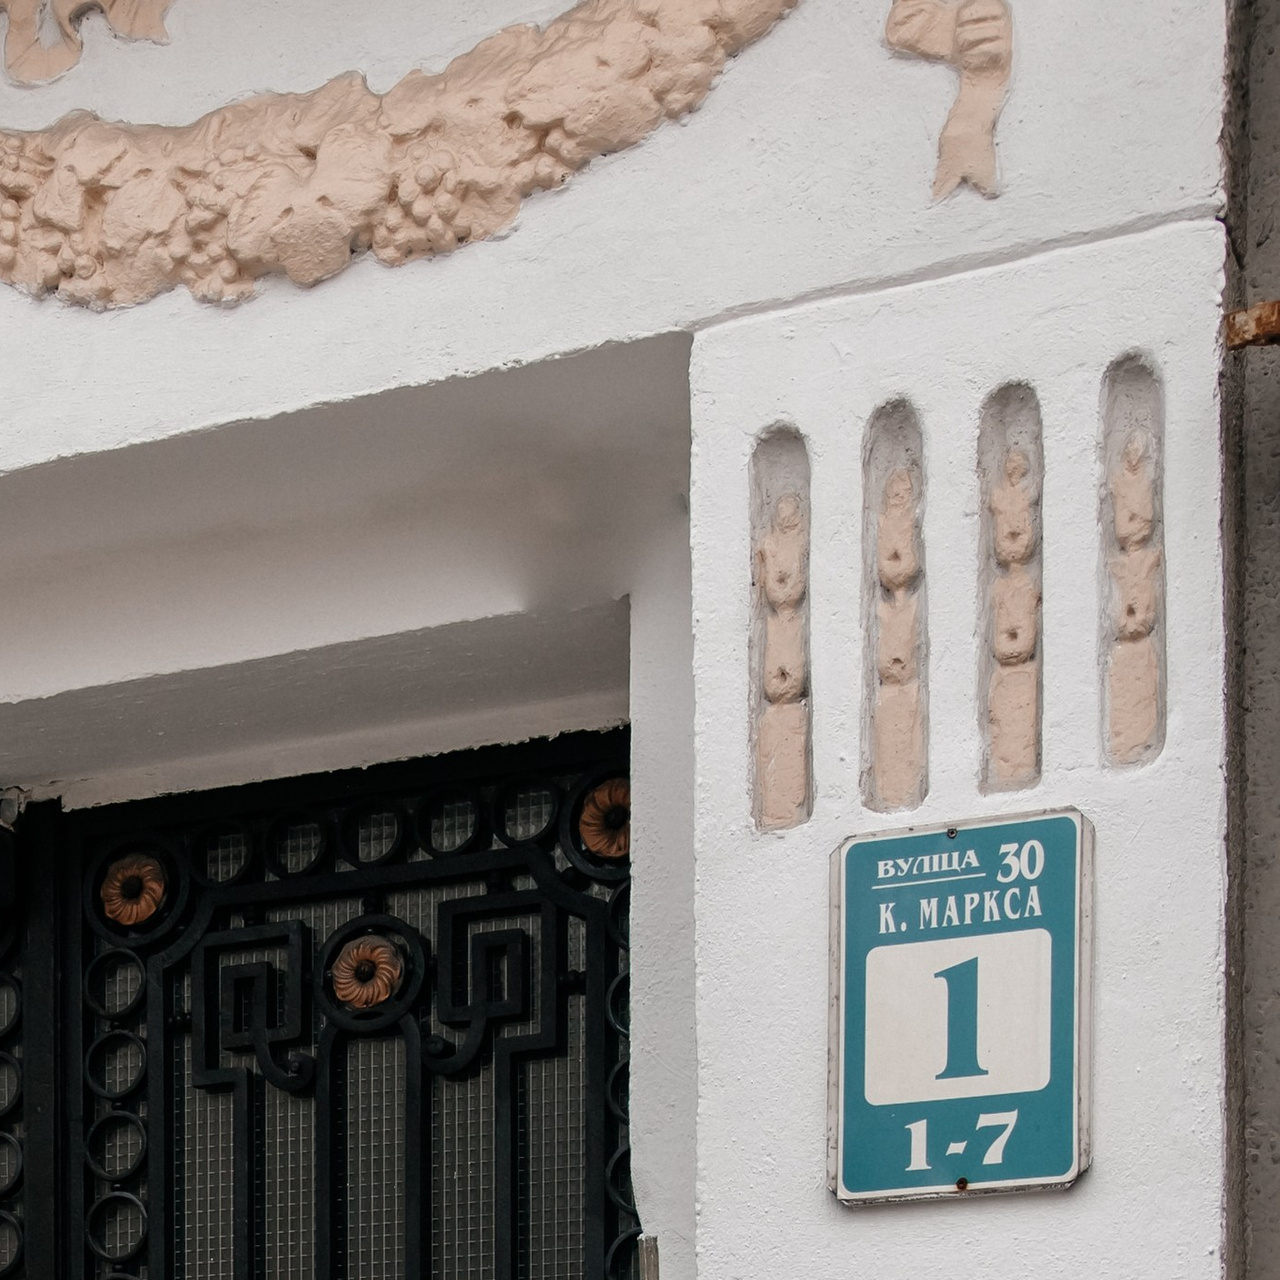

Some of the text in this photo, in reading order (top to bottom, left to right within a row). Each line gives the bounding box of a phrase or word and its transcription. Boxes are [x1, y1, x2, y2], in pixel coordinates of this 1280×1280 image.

[876, 839, 1046, 884] ВУЛІЦА 30
[878, 885, 1043, 935] К. МАРКСА
[933, 956, 989, 1080] 1
[904, 1108, 1019, 1172] 1-7
